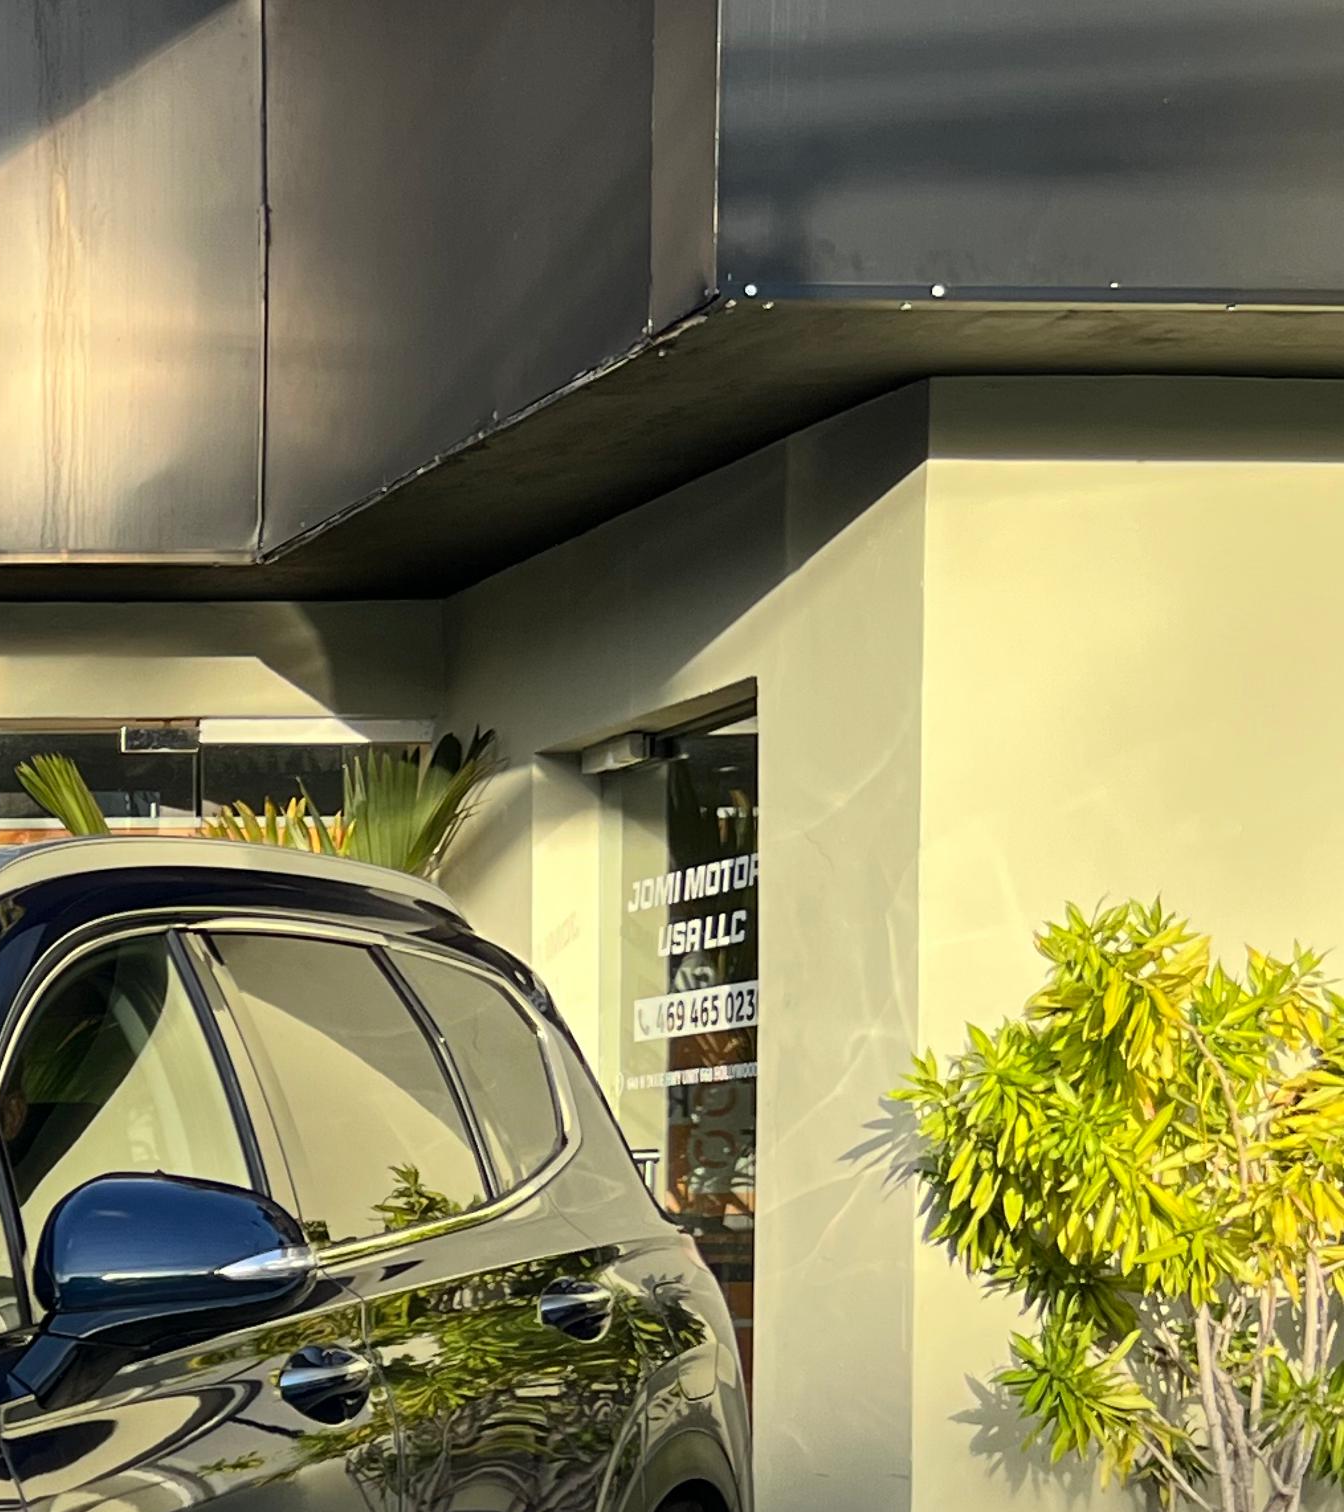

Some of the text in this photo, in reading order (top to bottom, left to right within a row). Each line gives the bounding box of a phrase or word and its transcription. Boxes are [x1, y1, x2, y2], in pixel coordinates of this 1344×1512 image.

[627, 870, 682, 913] JOMI
[657, 909, 747, 957] USA LLC
[656, 987, 759, 1033] 469 465 023
